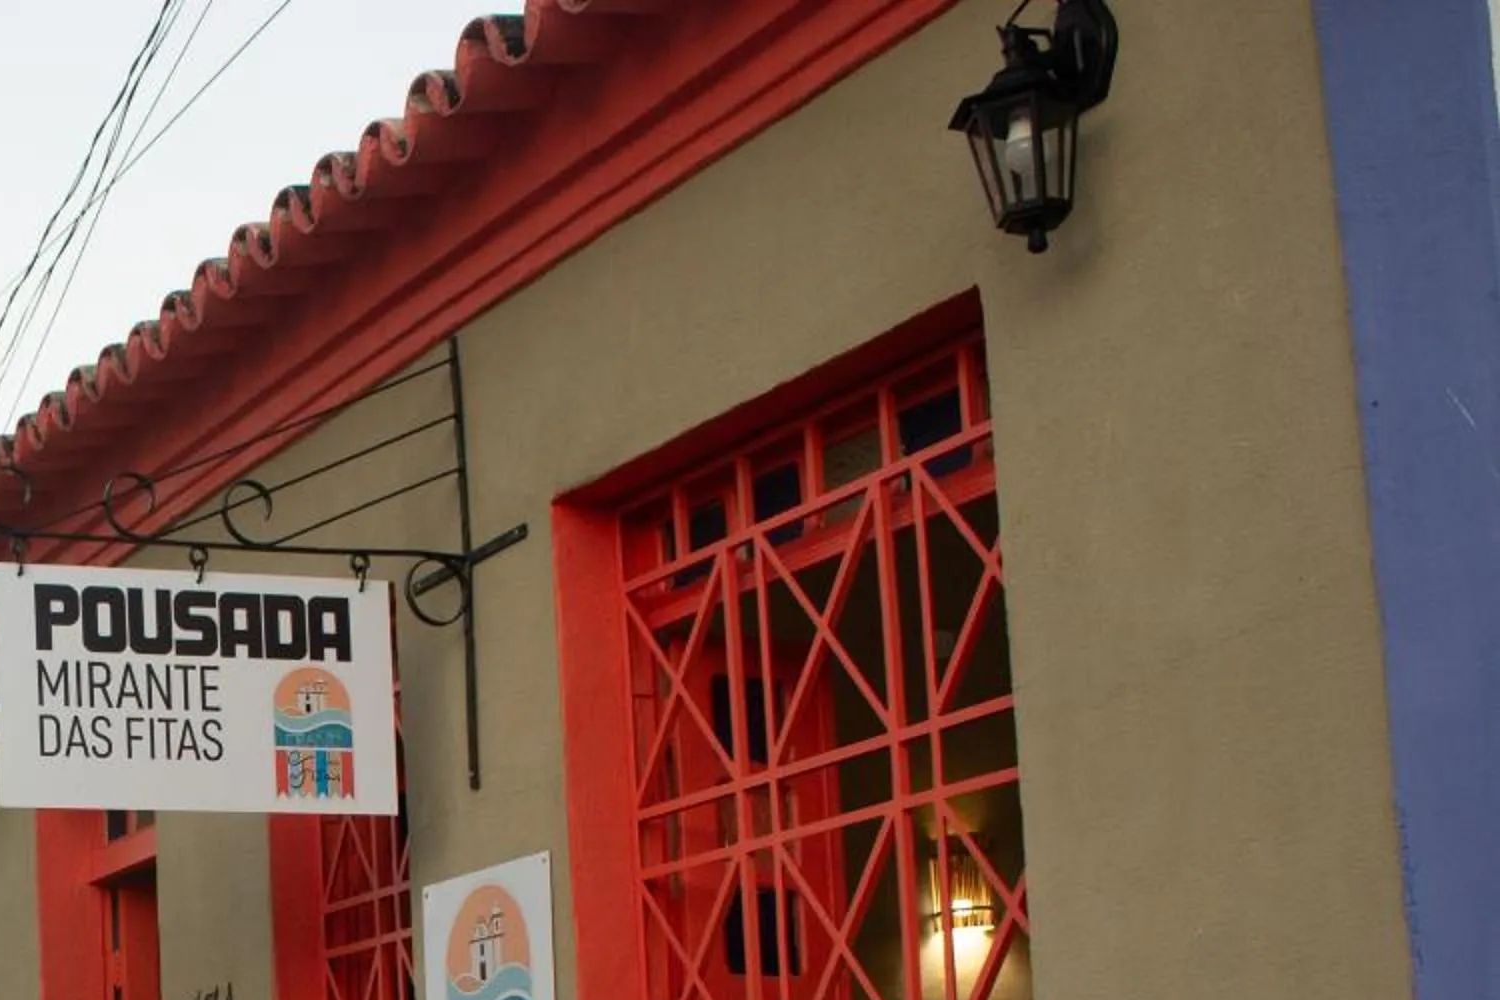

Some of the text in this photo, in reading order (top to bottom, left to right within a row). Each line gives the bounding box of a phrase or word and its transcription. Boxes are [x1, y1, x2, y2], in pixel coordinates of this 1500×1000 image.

[33, 583, 352, 663] POUSADA
[37, 659, 222, 712] MIRANTE
[39, 714, 224, 762] DAS FITAS
